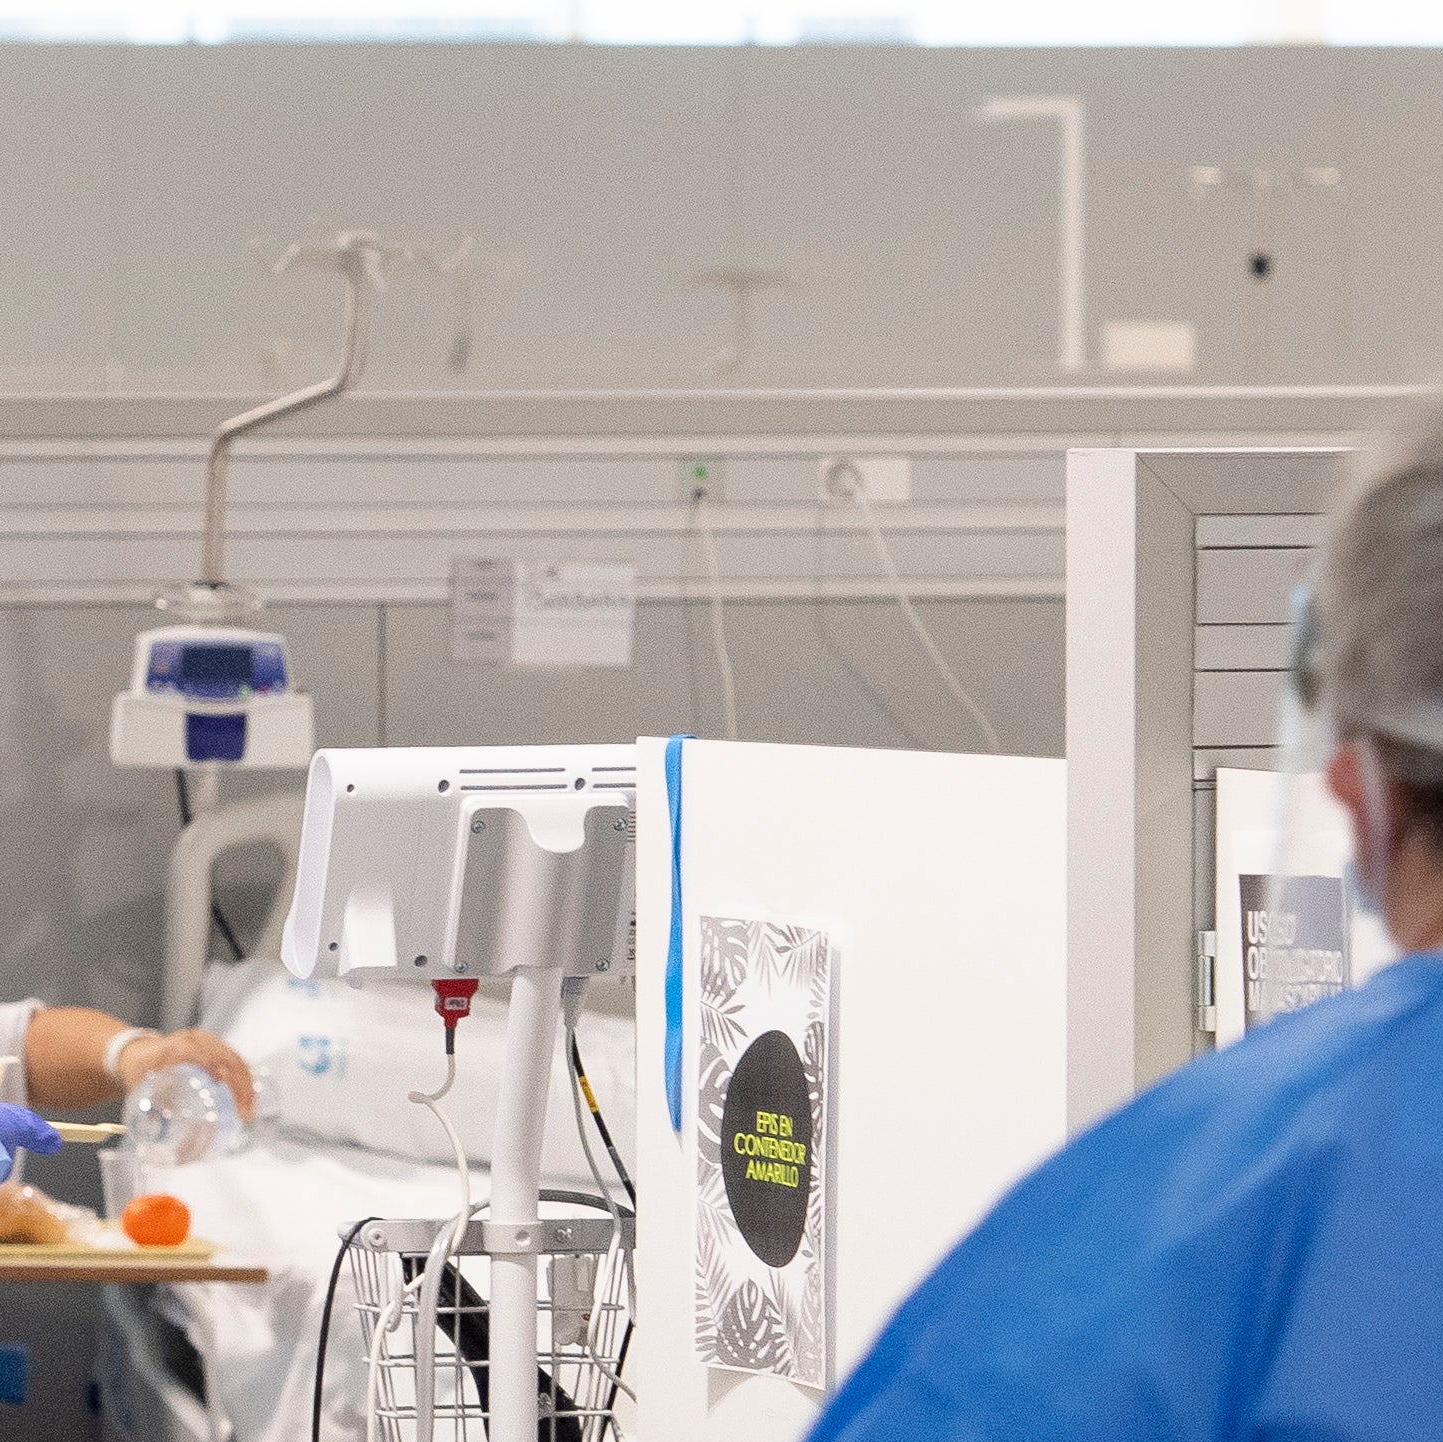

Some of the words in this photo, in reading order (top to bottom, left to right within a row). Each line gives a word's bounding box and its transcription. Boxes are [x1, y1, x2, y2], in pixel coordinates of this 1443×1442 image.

[779, 1114, 794, 1137] EN
[734, 1132, 807, 1165] CONTENEDOR
[745, 1159, 799, 1188] AMARILLO
